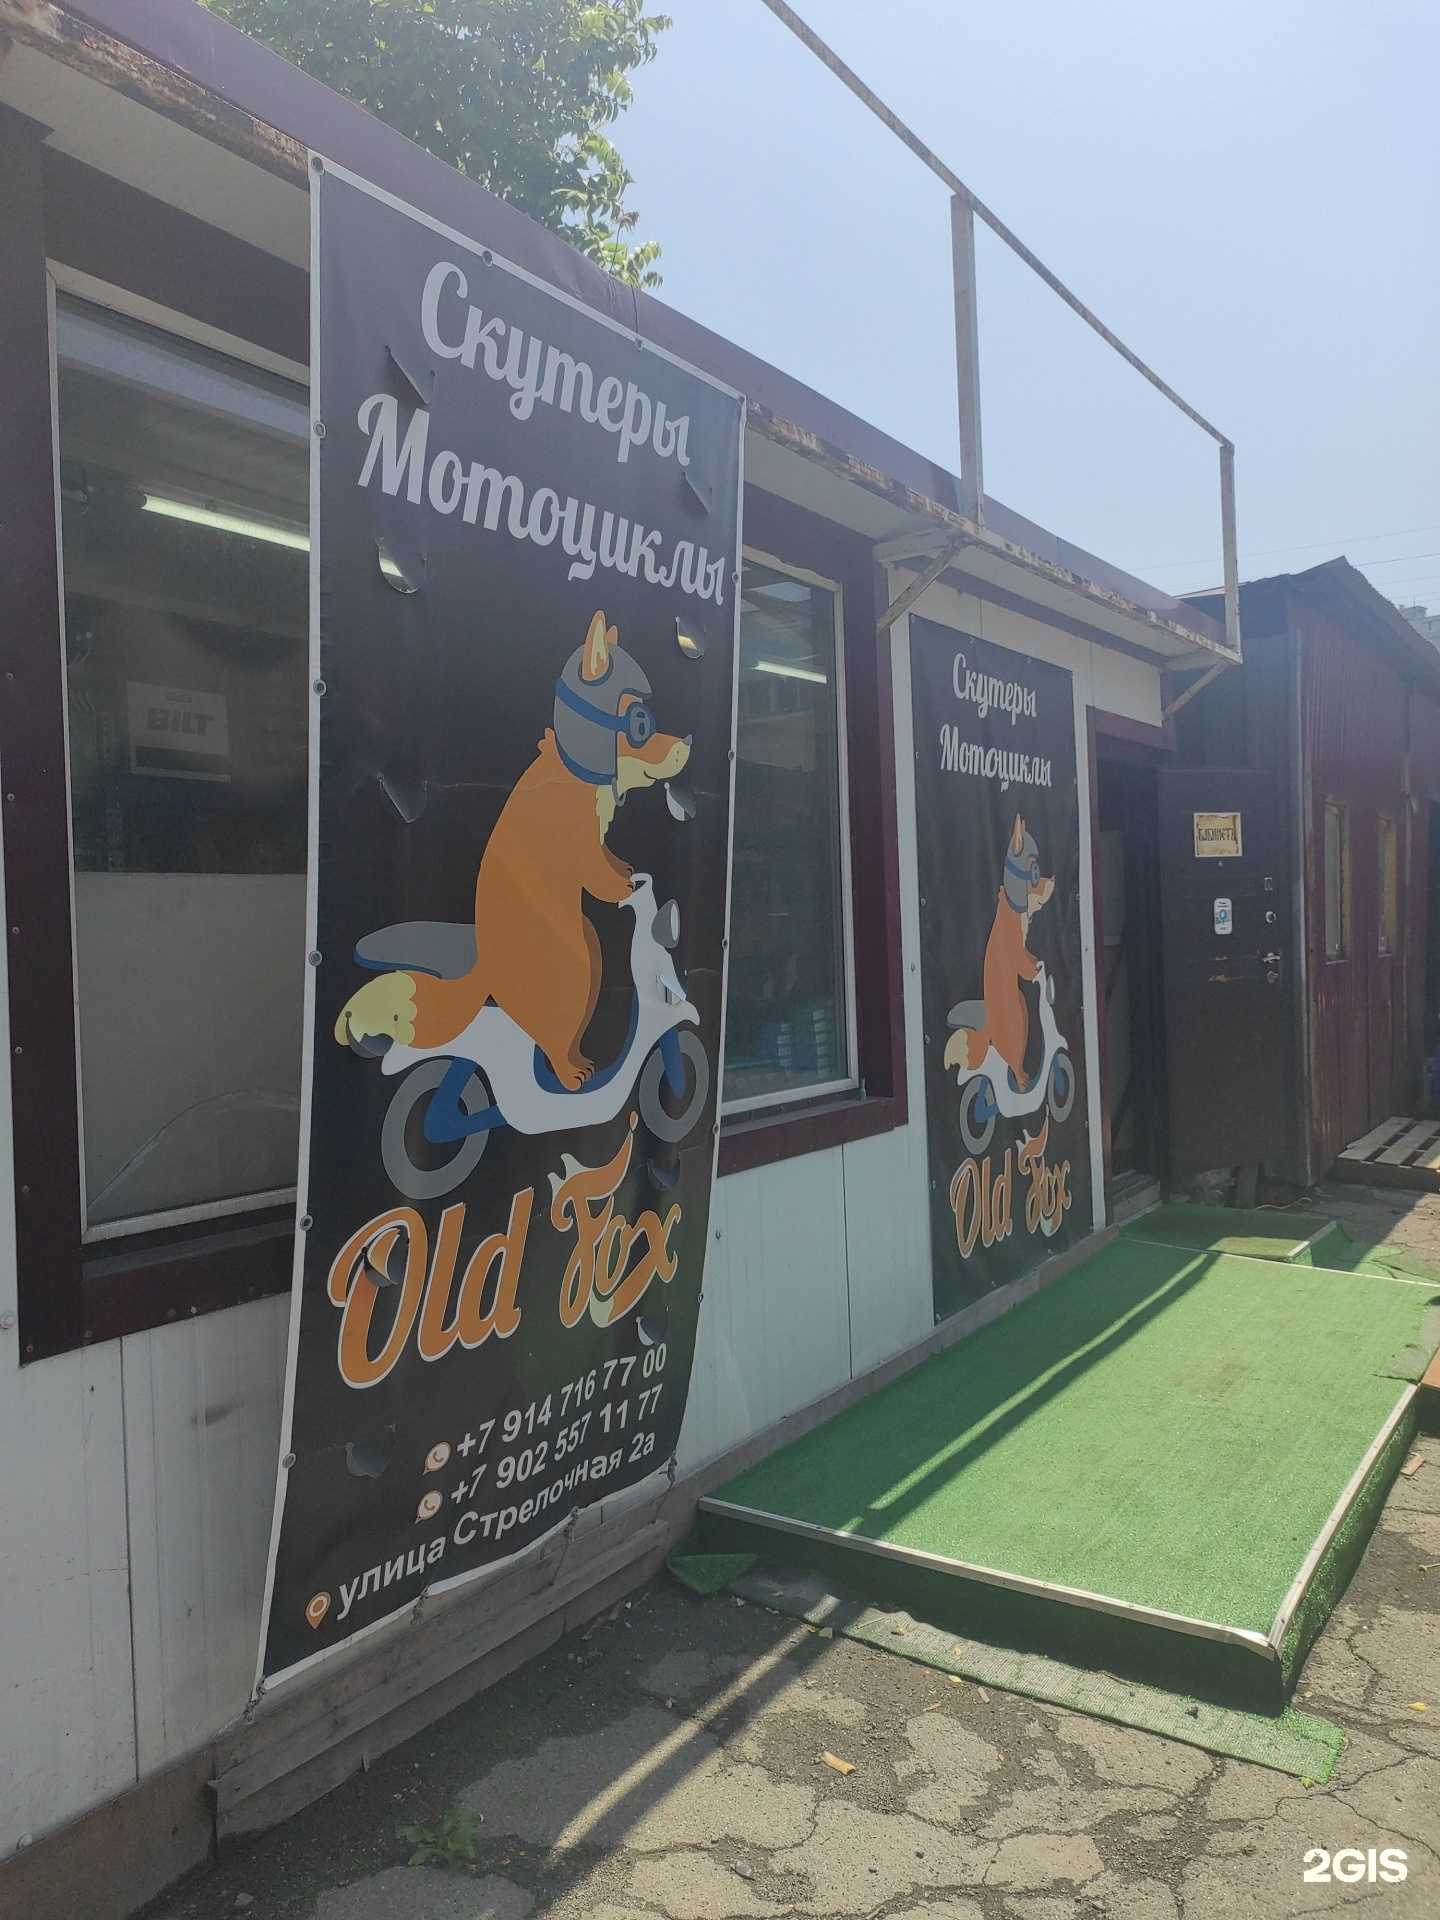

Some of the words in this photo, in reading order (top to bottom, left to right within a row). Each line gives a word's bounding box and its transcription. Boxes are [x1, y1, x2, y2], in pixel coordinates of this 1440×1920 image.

[421, 261, 690, 466] Скутеры
[357, 394, 726, 606] Мотоциклы
[940, 723, 1053, 793] Мотоциклы
[952, 652, 1037, 726] Скутеры
[327, 1187, 535, 1389] Old
[547, 1110, 682, 1328] Fox
[950, 1148, 1014, 1259] Old
[1015, 1103, 1073, 1238] Fox
[450, 1463, 488, 1504] +7
[495, 1440, 549, 1489] 902
[554, 1410, 592, 1461] 557
[599, 1399, 629, 1433] 11
[637, 1383, 663, 1421] 77
[456, 1418, 496, 1457] +7
[502, 1393, 552, 1443] 914
[560, 1369, 597, 1417] 716
[602, 1355, 637, 1391] 77
[642, 1342, 667, 1378] 00
[336, 1535, 447, 1620] улица
[453, 1447, 623, 1541] Стрелочная
[627, 1432, 656, 1463] 2а
